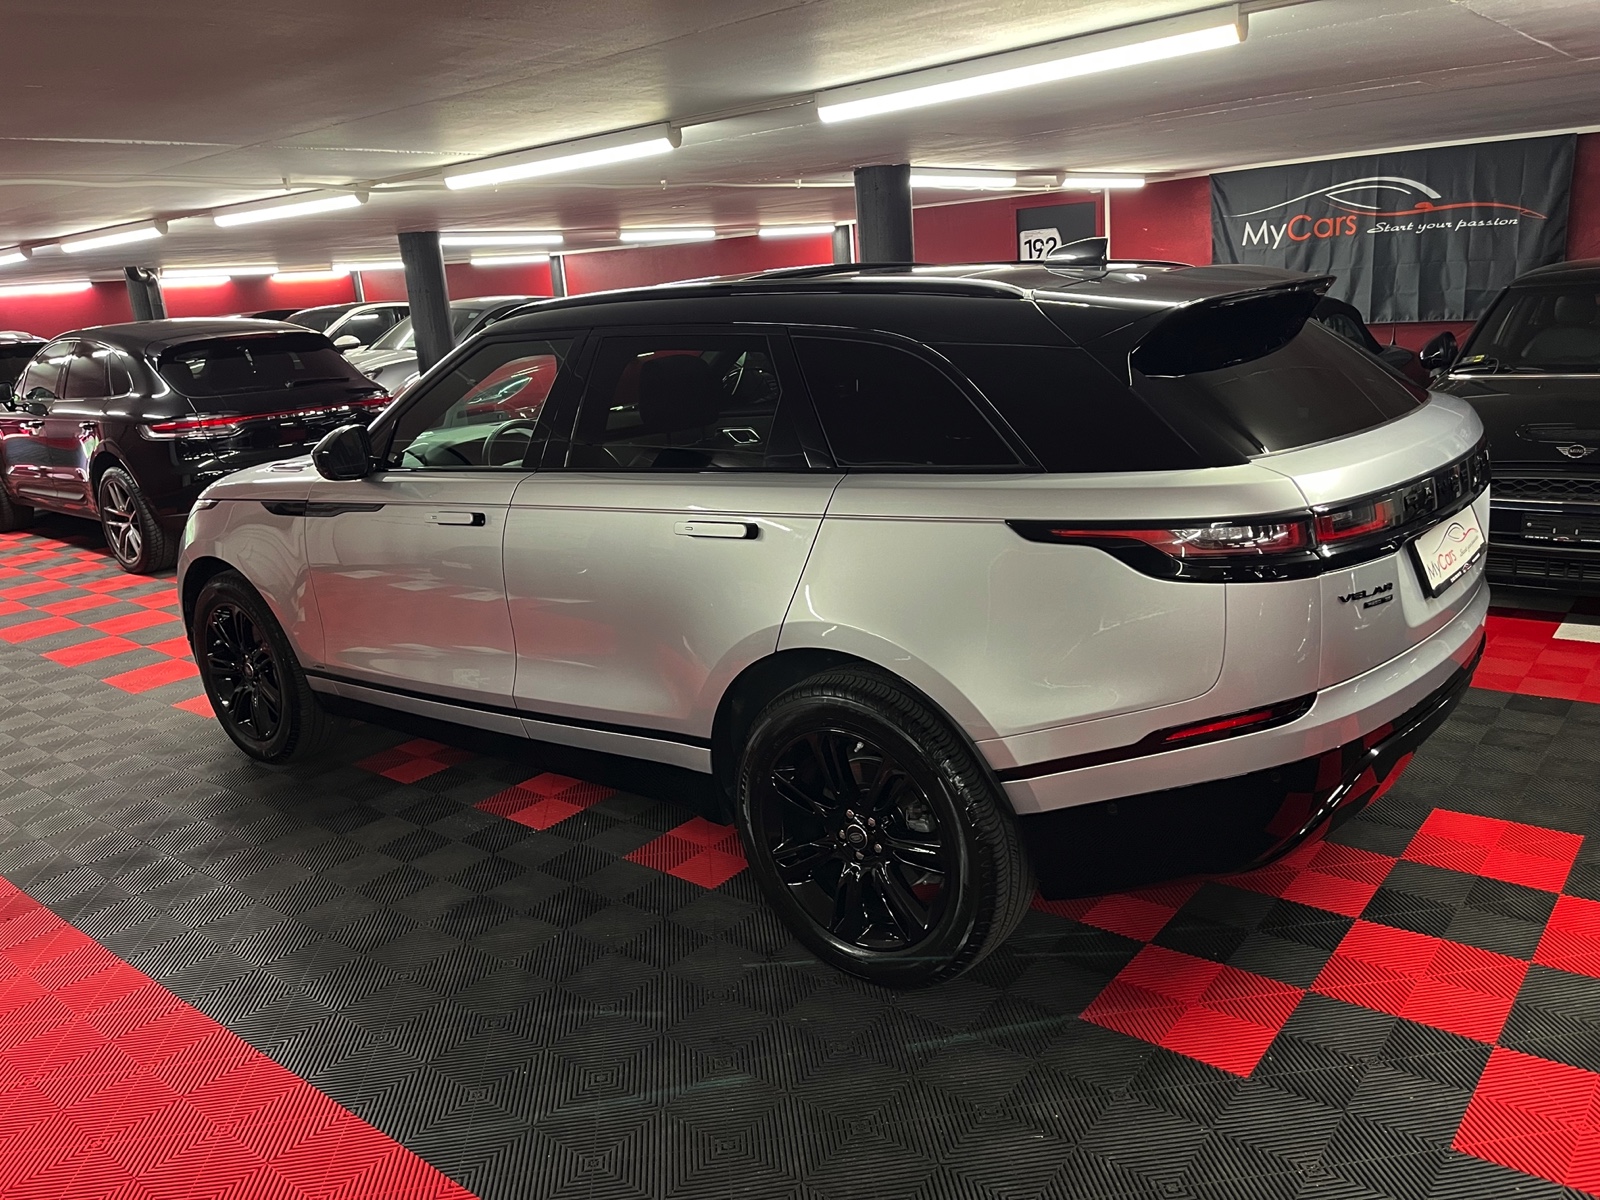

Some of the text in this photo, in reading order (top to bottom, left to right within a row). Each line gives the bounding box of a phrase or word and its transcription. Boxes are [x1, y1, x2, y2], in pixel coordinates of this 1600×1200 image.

[1241, 214, 1357, 250] MyCars
[1366, 218, 1518, 234] Start your passion
[1024, 236, 1057, 260] 192
[1427, 549, 1458, 580] MyCars
[1337, 582, 1393, 603] VELAR
